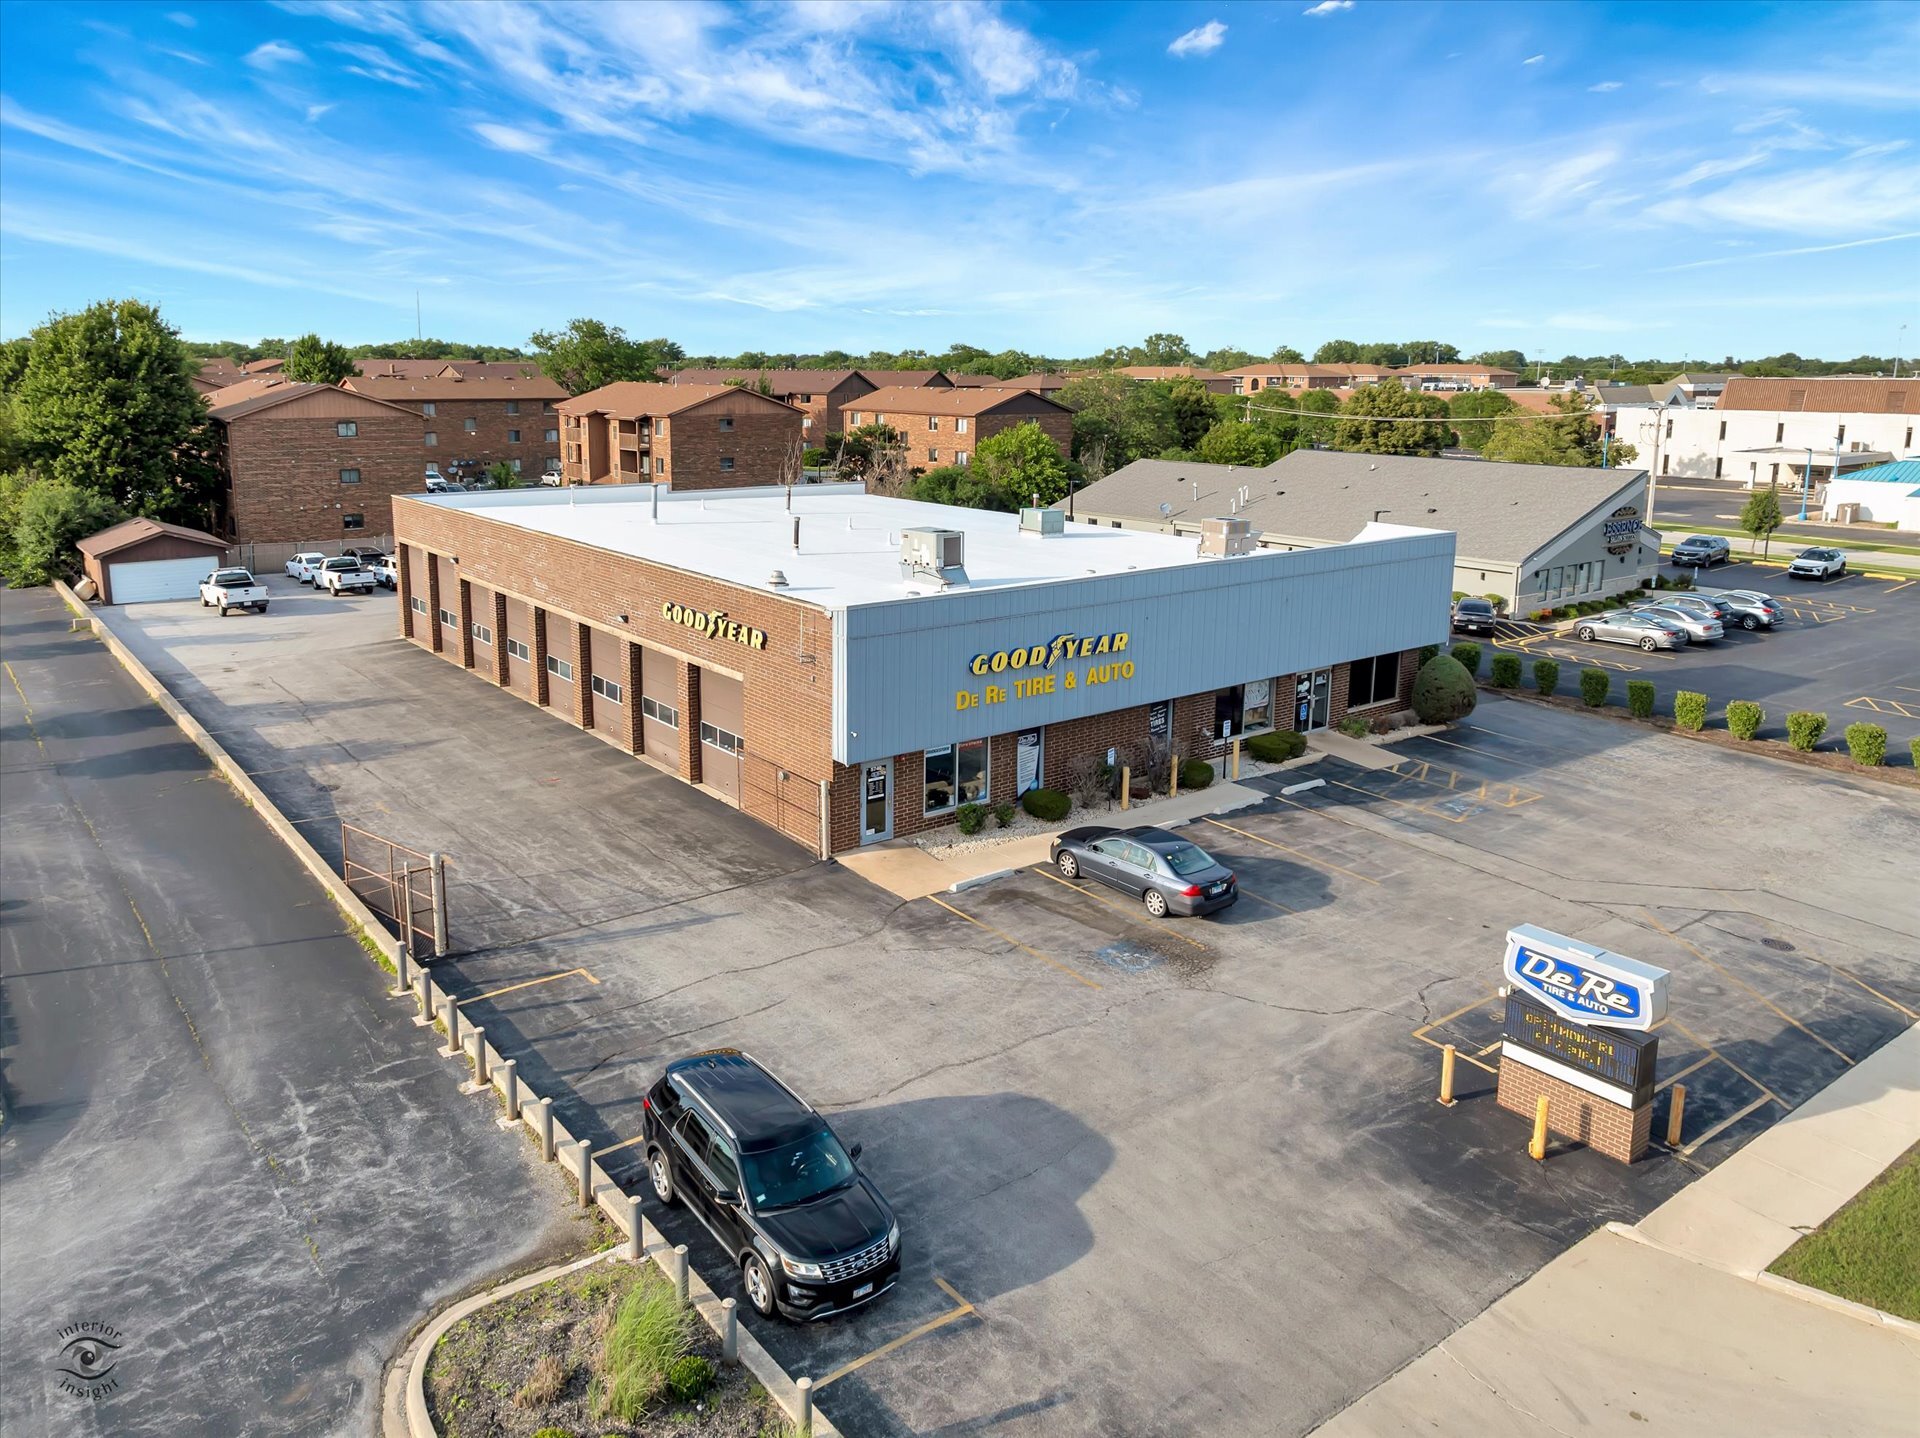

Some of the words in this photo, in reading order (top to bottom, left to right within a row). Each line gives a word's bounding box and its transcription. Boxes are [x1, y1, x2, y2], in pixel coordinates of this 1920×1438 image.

[662, 601, 767, 650] GOODYEAR
[970, 632, 1129, 675] GOODYEAR
[1013, 674, 1057, 699] TIRE
[1064, 671, 1077, 689] &
[1086, 660, 1135, 685] AUTO
[1522, 951, 1577, 992] De
[1579, 971, 1635, 1014] Re
[1542, 982, 1566, 999] TIRE
[1567, 991, 1576, 1002] &
[1577, 996, 1609, 1014] AUTO
